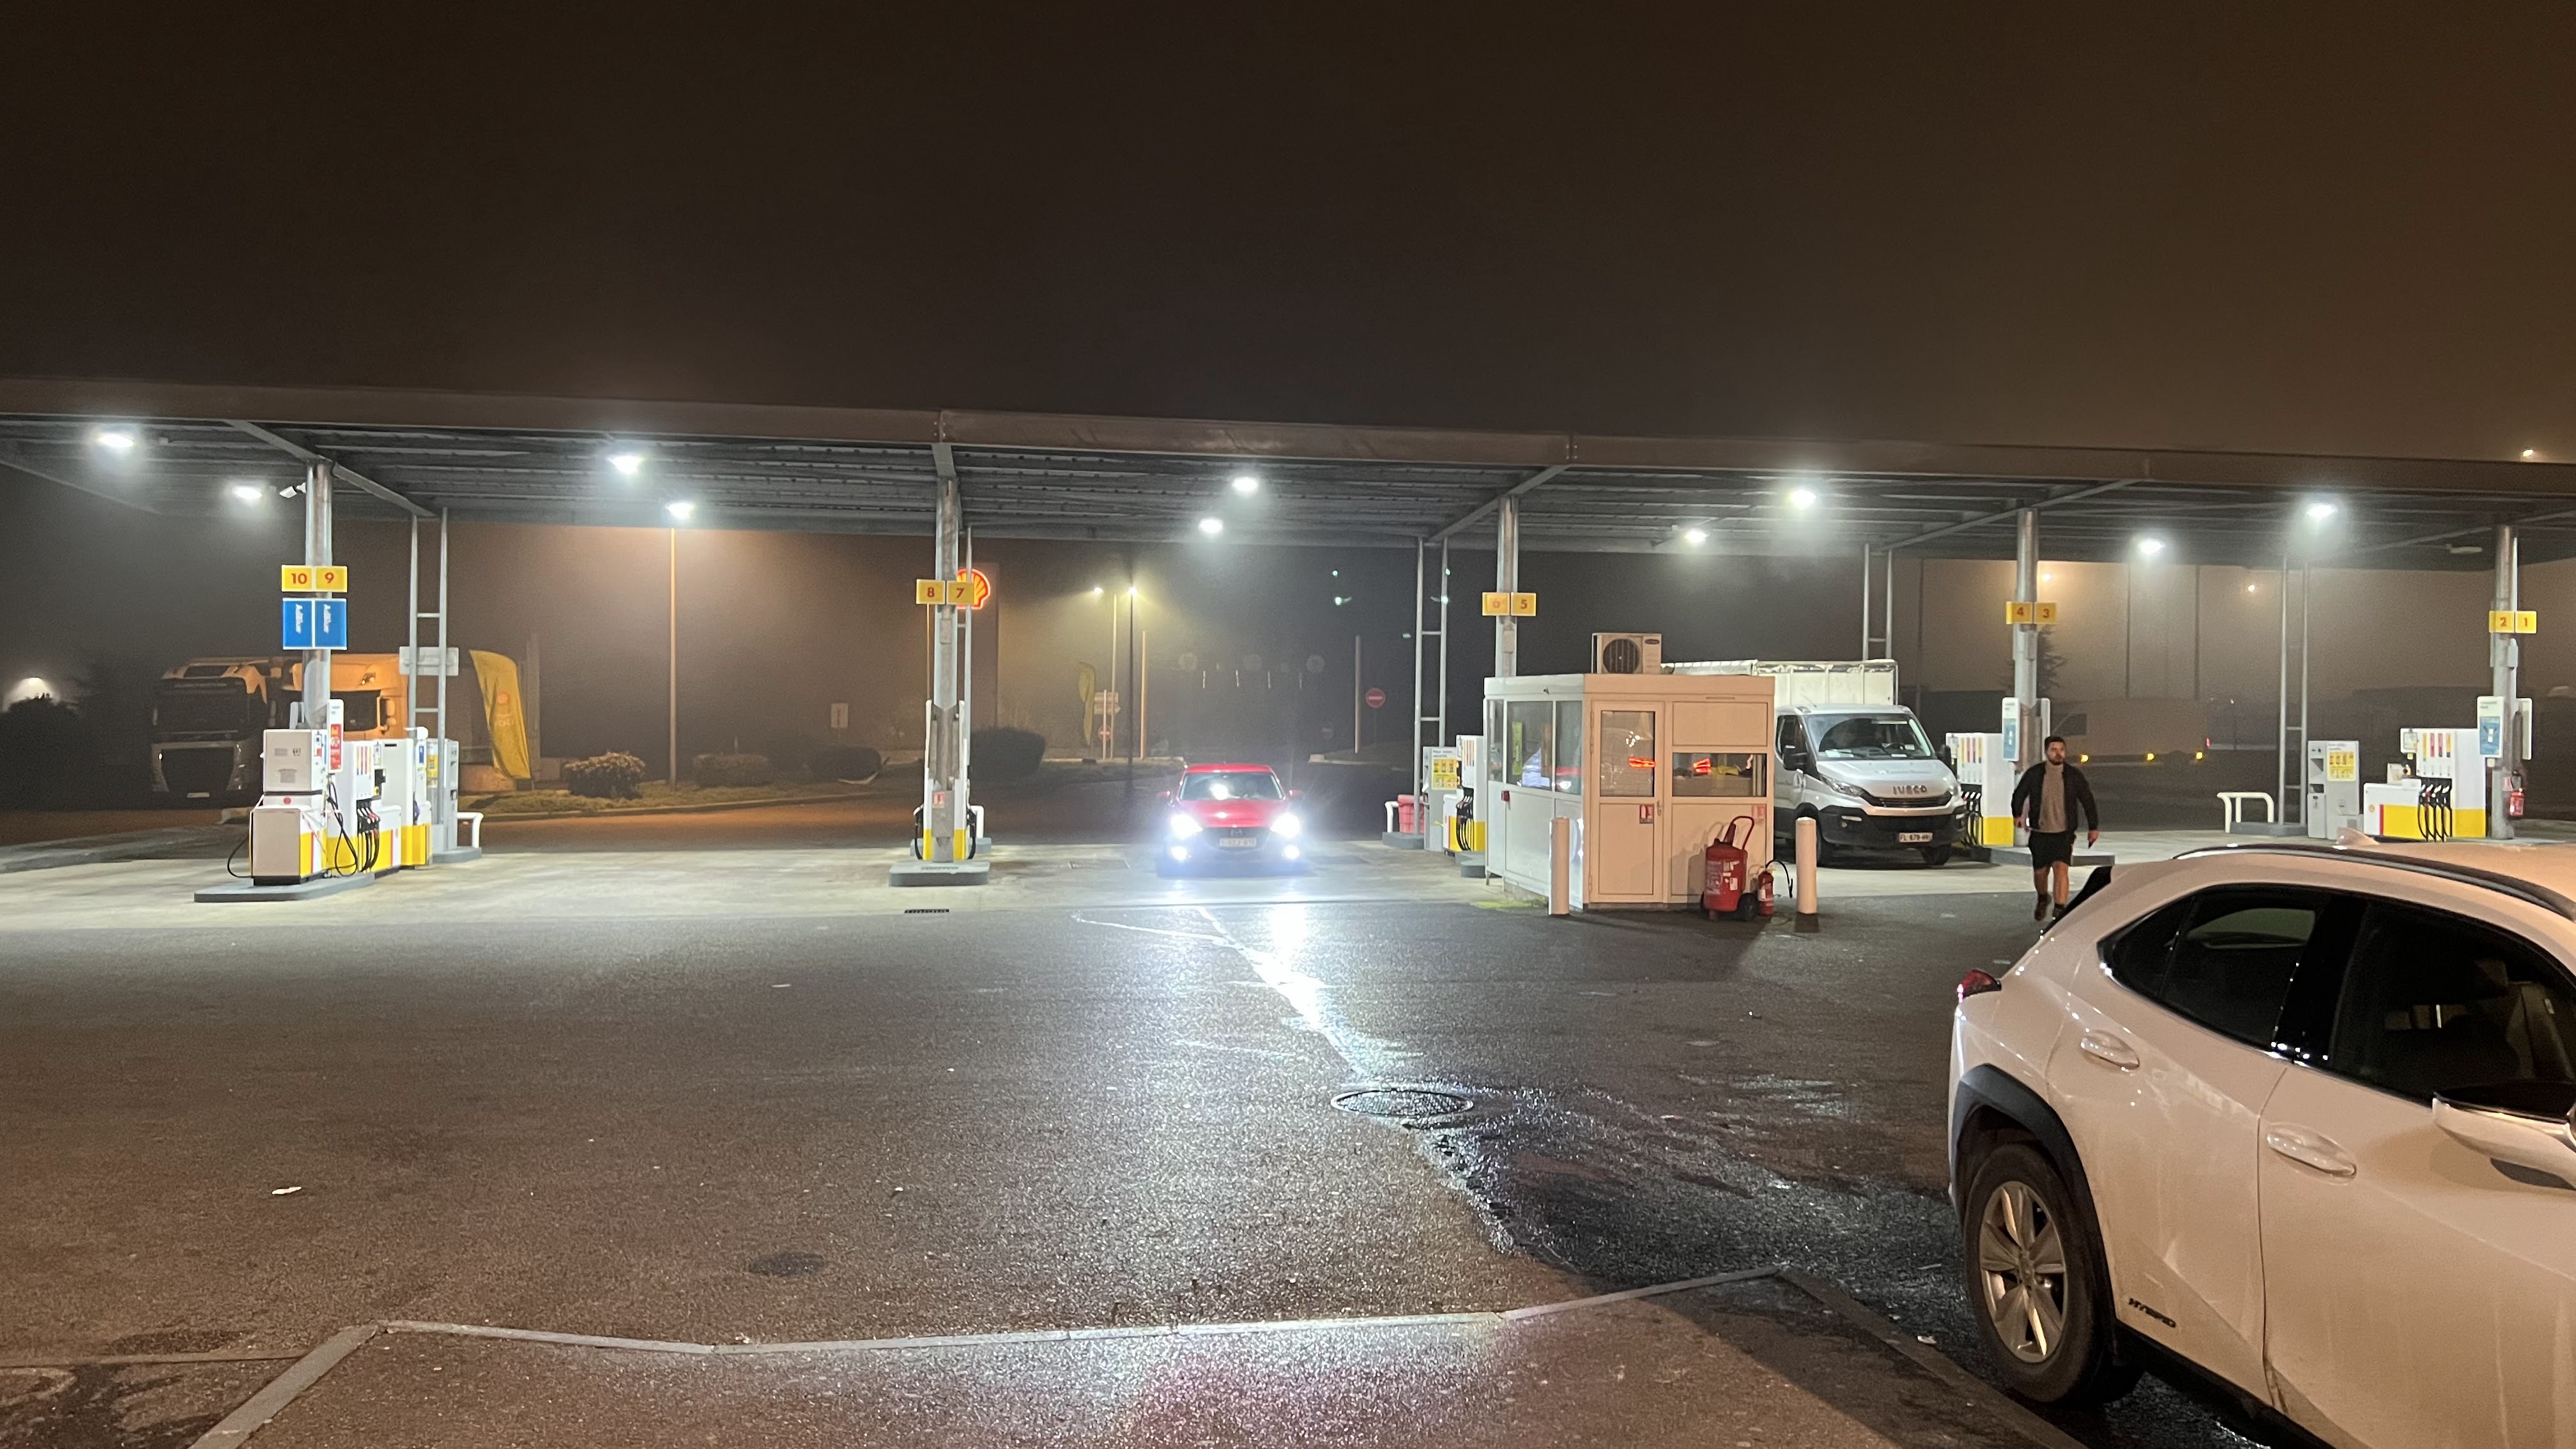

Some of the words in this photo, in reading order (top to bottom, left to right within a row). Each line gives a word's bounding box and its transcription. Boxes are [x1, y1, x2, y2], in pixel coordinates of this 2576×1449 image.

[291, 572, 308, 585] 10
[325, 572, 335, 584] 9
[927, 586, 935, 597] 8
[956, 587, 965, 598] 7
[1520, 599, 1528, 610] 5
[2017, 607, 2024, 617] 4
[2043, 608, 2050, 618] 3
[2500, 617, 2507, 627] 2
[2524, 617, 2528, 627] 1
[1892, 785, 1928, 795] IVECO
